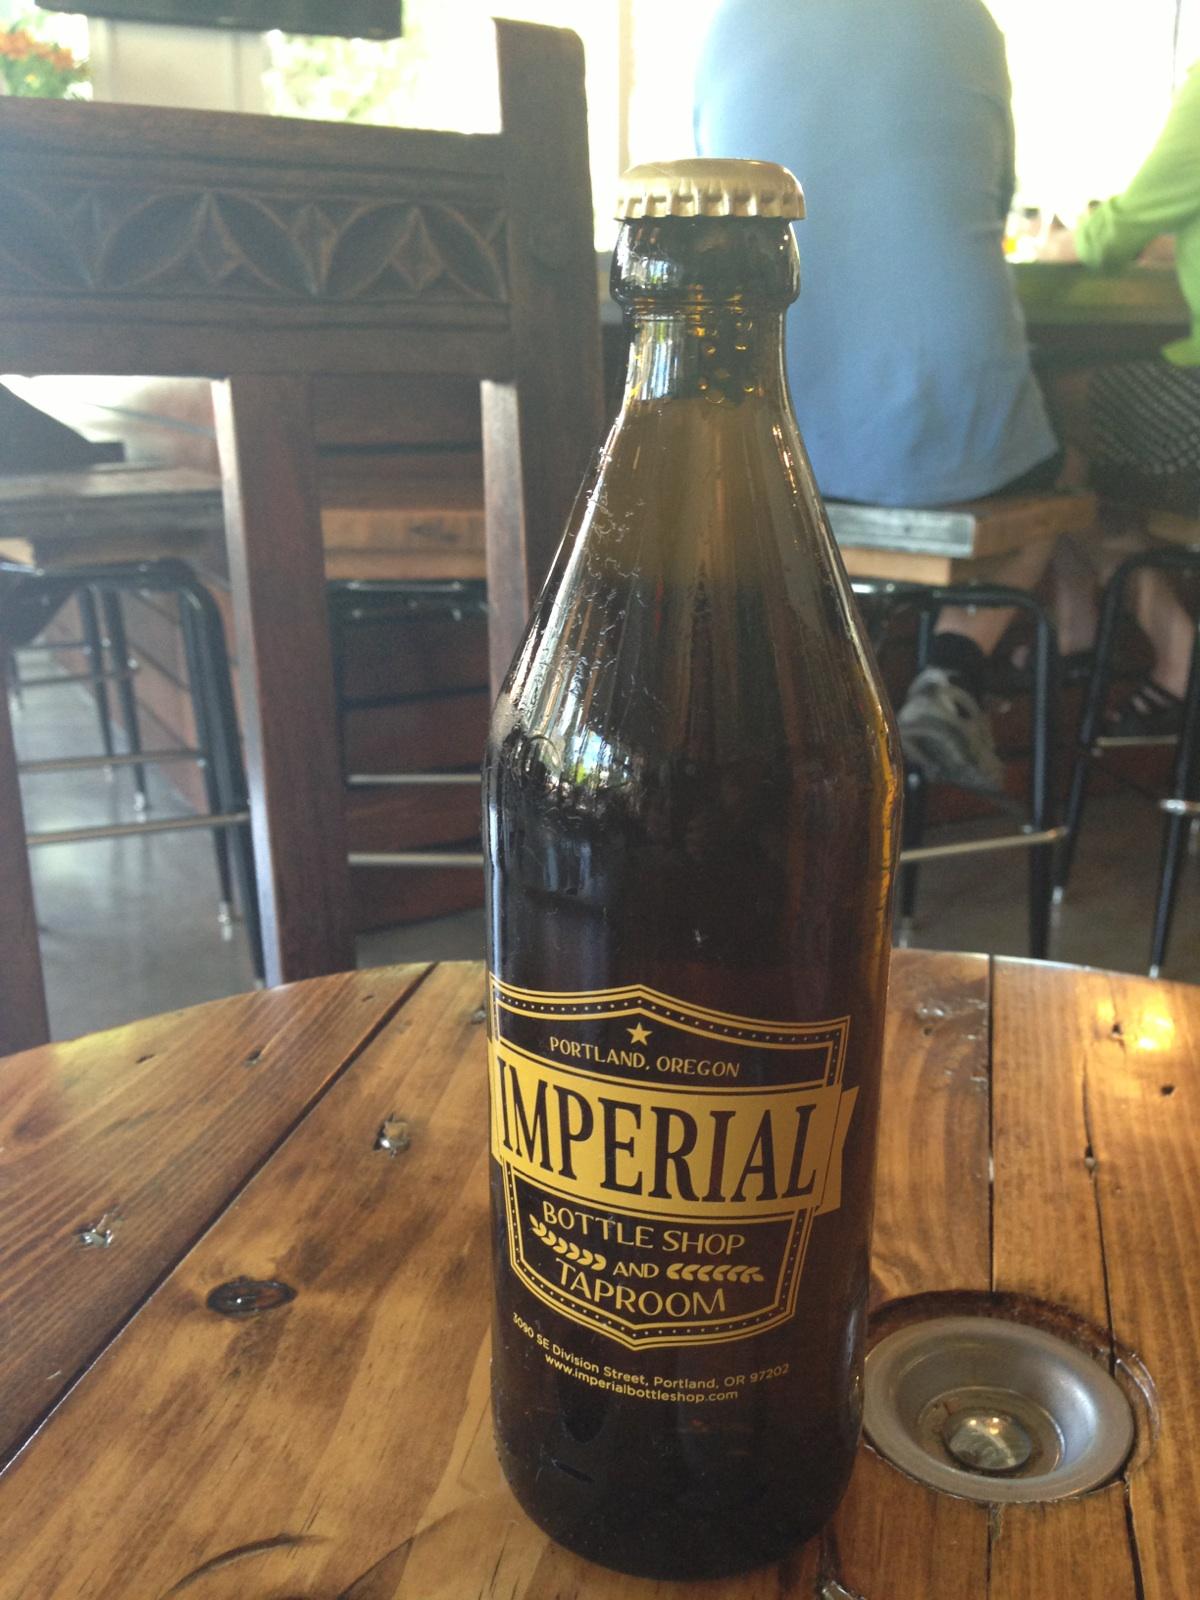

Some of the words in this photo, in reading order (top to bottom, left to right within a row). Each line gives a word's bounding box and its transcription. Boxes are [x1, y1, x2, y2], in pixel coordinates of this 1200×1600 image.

[656, 1056, 740, 1078] OREGON
[497, 1056, 817, 1202] IMPERIAL
[542, 1200, 654, 1249] BOTTLE
[661, 1229, 746, 1256] SHOP
[555, 1257, 727, 1318] TAPROOM
[612, 1261, 660, 1279] AND
[536, 1333, 550, 1351] SE
[552, 1343, 600, 1374] Division
[723, 1375, 746, 1388] OR
[750, 1363, 789, 1383] 97202
[545, 1354, 738, 1403] www.imperialbottleshop.com
